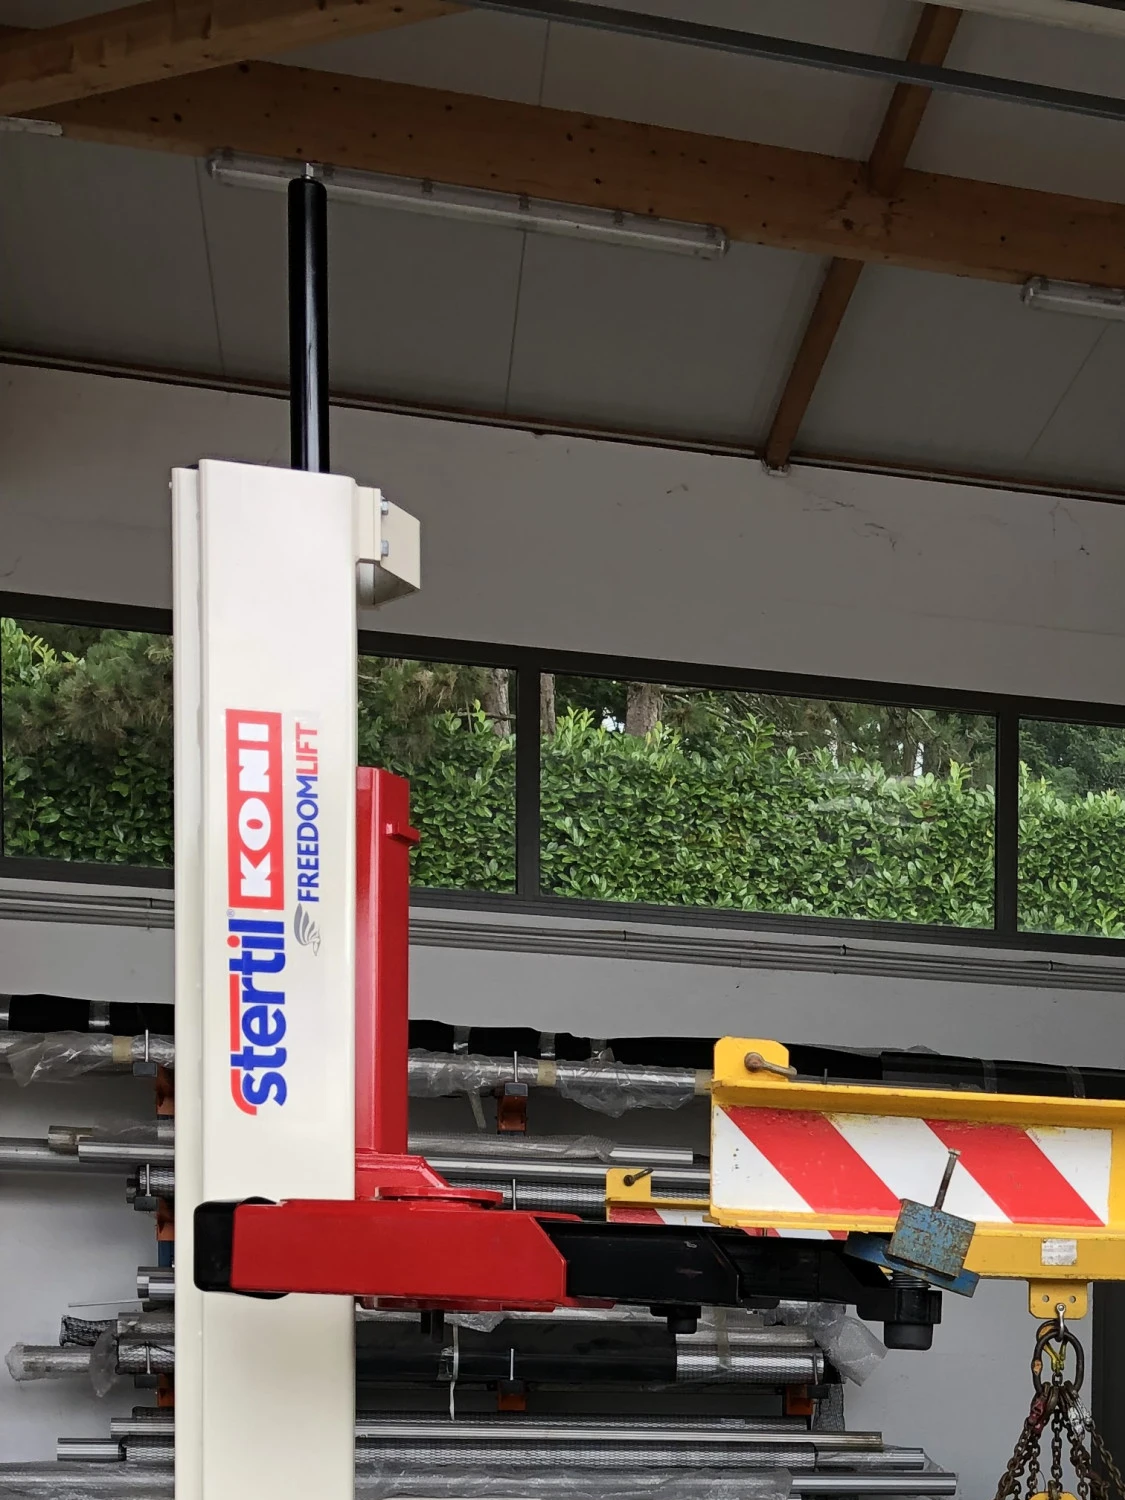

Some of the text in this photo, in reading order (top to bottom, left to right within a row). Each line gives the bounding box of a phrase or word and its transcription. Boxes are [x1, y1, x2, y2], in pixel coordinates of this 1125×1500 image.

[227, 721, 287, 1115] stertil KONI
[294, 722, 319, 903] FREEDOMLIFT
